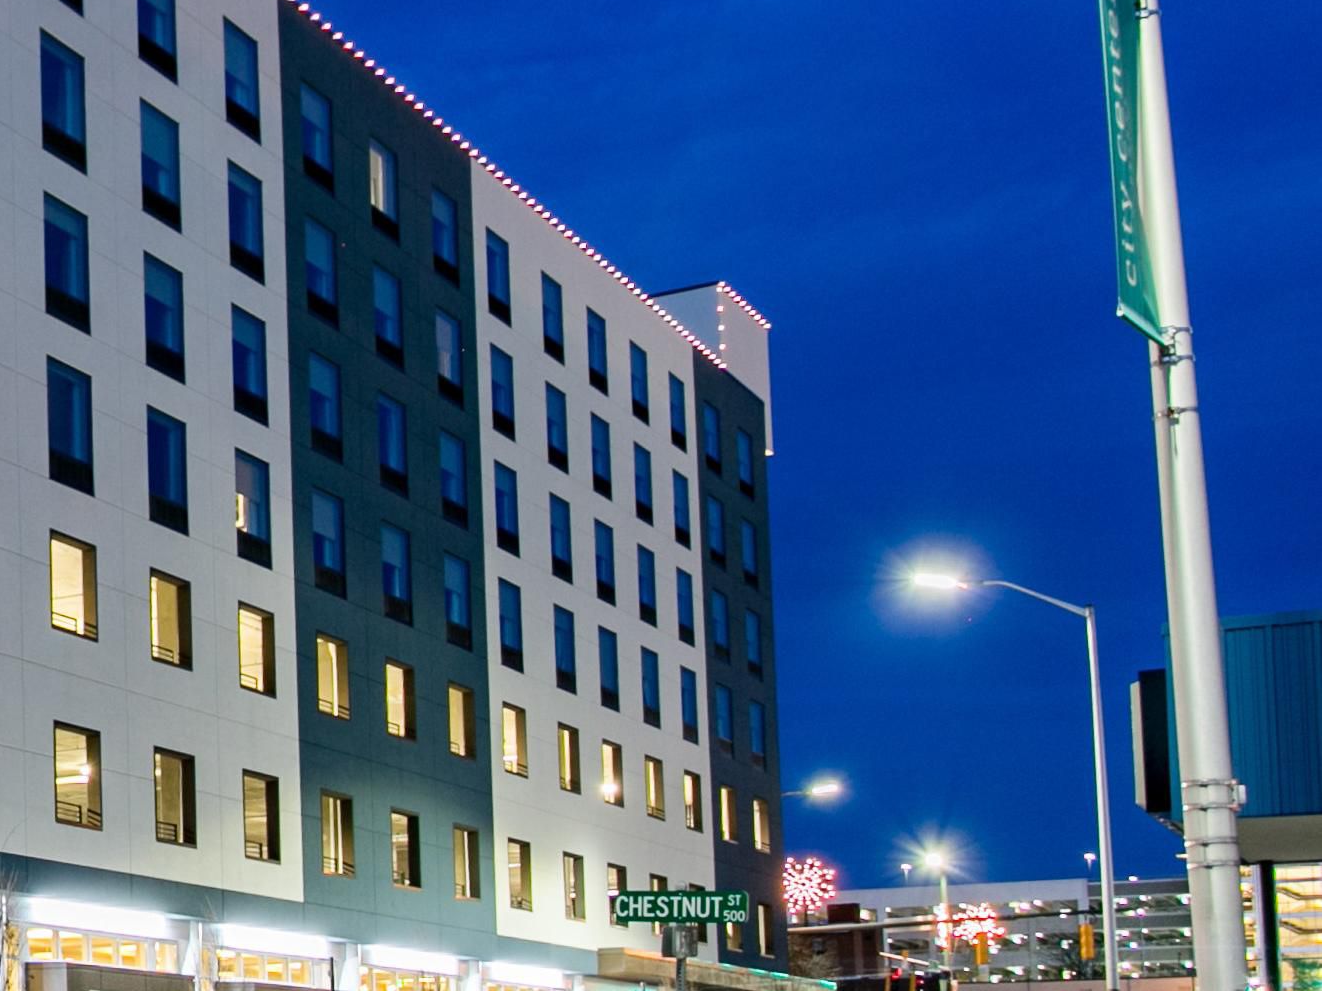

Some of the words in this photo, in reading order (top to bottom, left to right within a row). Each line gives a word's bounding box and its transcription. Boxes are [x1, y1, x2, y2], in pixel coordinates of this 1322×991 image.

[1120, 179, 1137, 287] city
[615, 894, 723, 918] CHESTNUT
[727, 893, 742, 906] ST
[722, 909, 746, 923] 500
